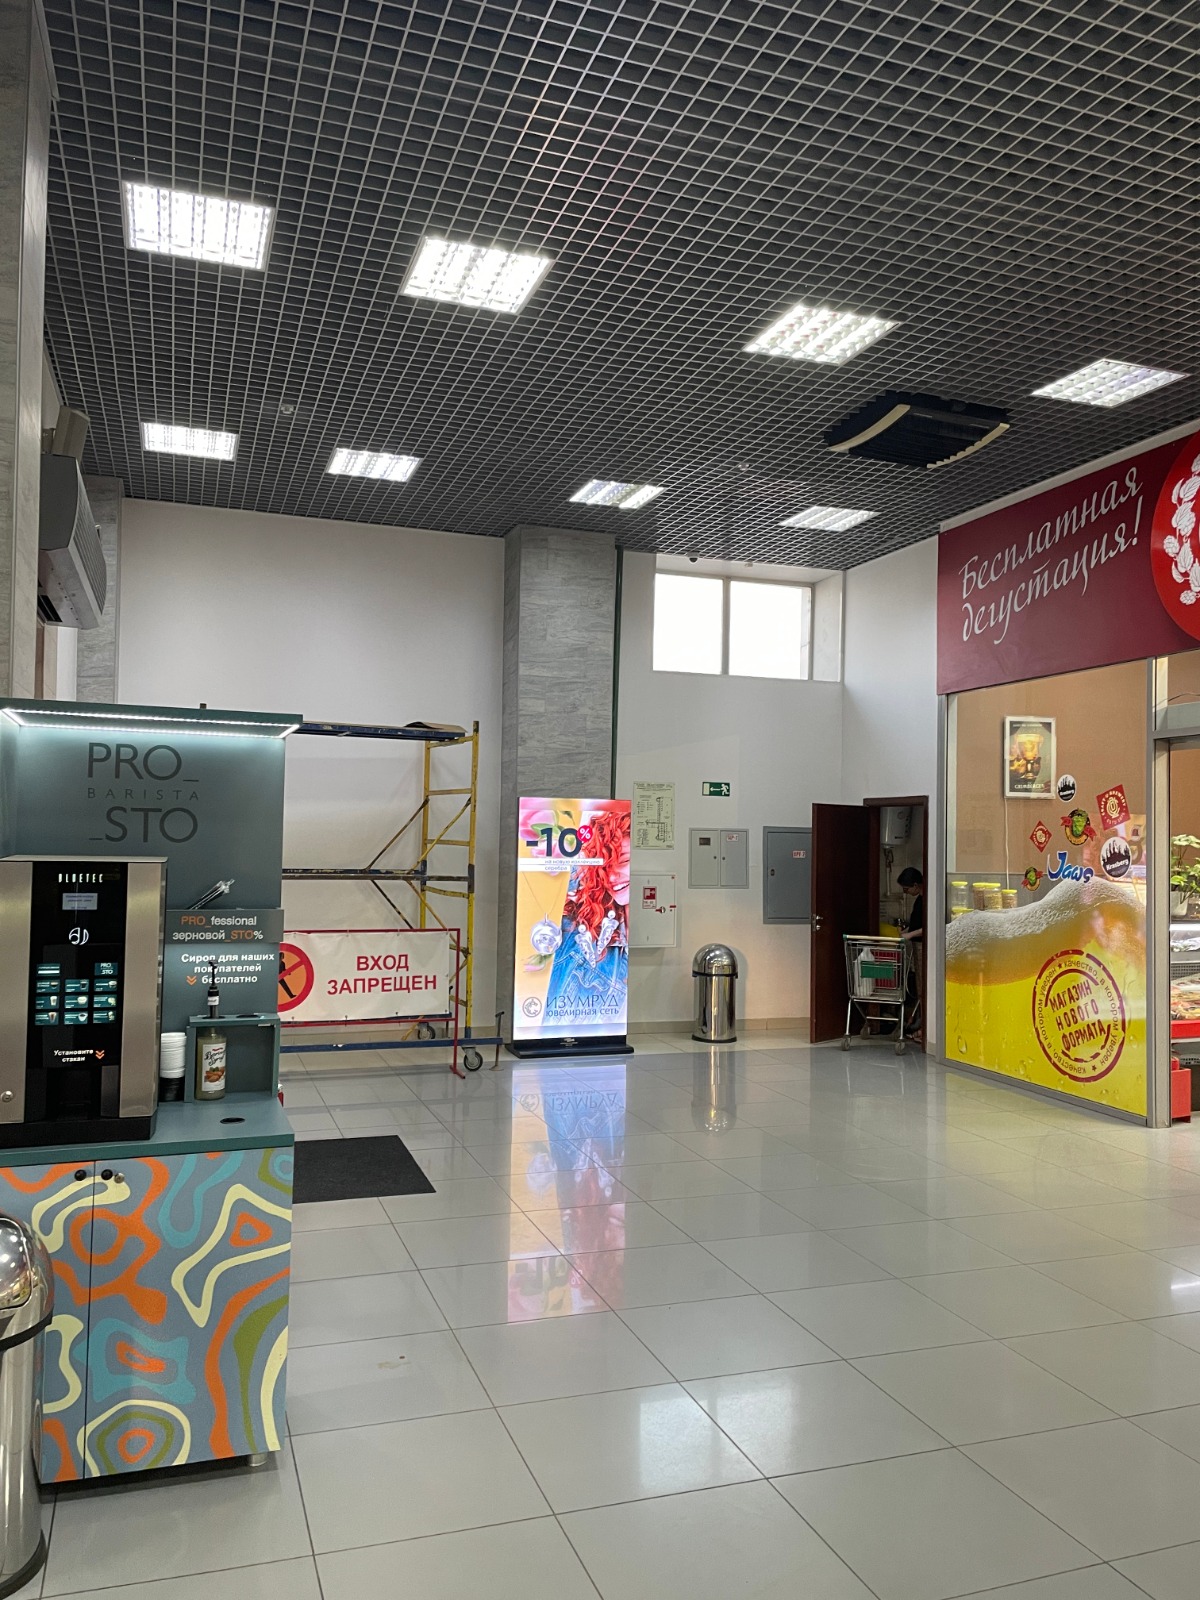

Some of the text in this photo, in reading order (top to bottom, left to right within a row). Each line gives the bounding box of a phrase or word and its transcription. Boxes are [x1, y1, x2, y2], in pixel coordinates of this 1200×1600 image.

[959, 466, 1143, 599] Бесплатная
[961, 495, 1143, 645] дегустация!
[87, 787, 199, 801] BARISTA
[1047, 850, 1094, 884] Jaws
[181, 953, 275, 964] Сироп для наших
[356, 954, 410, 972] ВХОД
[327, 974, 437, 996] ЗАПРЕЩЕН
[1040, 967, 1057, 997] уверен
[1049, 979, 1092, 1013] МАГАЗИН
[1099, 978, 1105, 986] в
[546, 994, 619, 1009] ИЗУМРУД
[546, 1008, 620, 1018] ювелирная сеть
[1055, 998, 1099, 1032] НОВОГО
[1105, 984, 1120, 1032] котором
[1038, 999, 1049, 1042] котором
[1061, 1018, 1106, 1052] ФОРМАТА
[54, 1049, 94, 1057] Установите
[1099, 1033, 1118, 1067] уверен
